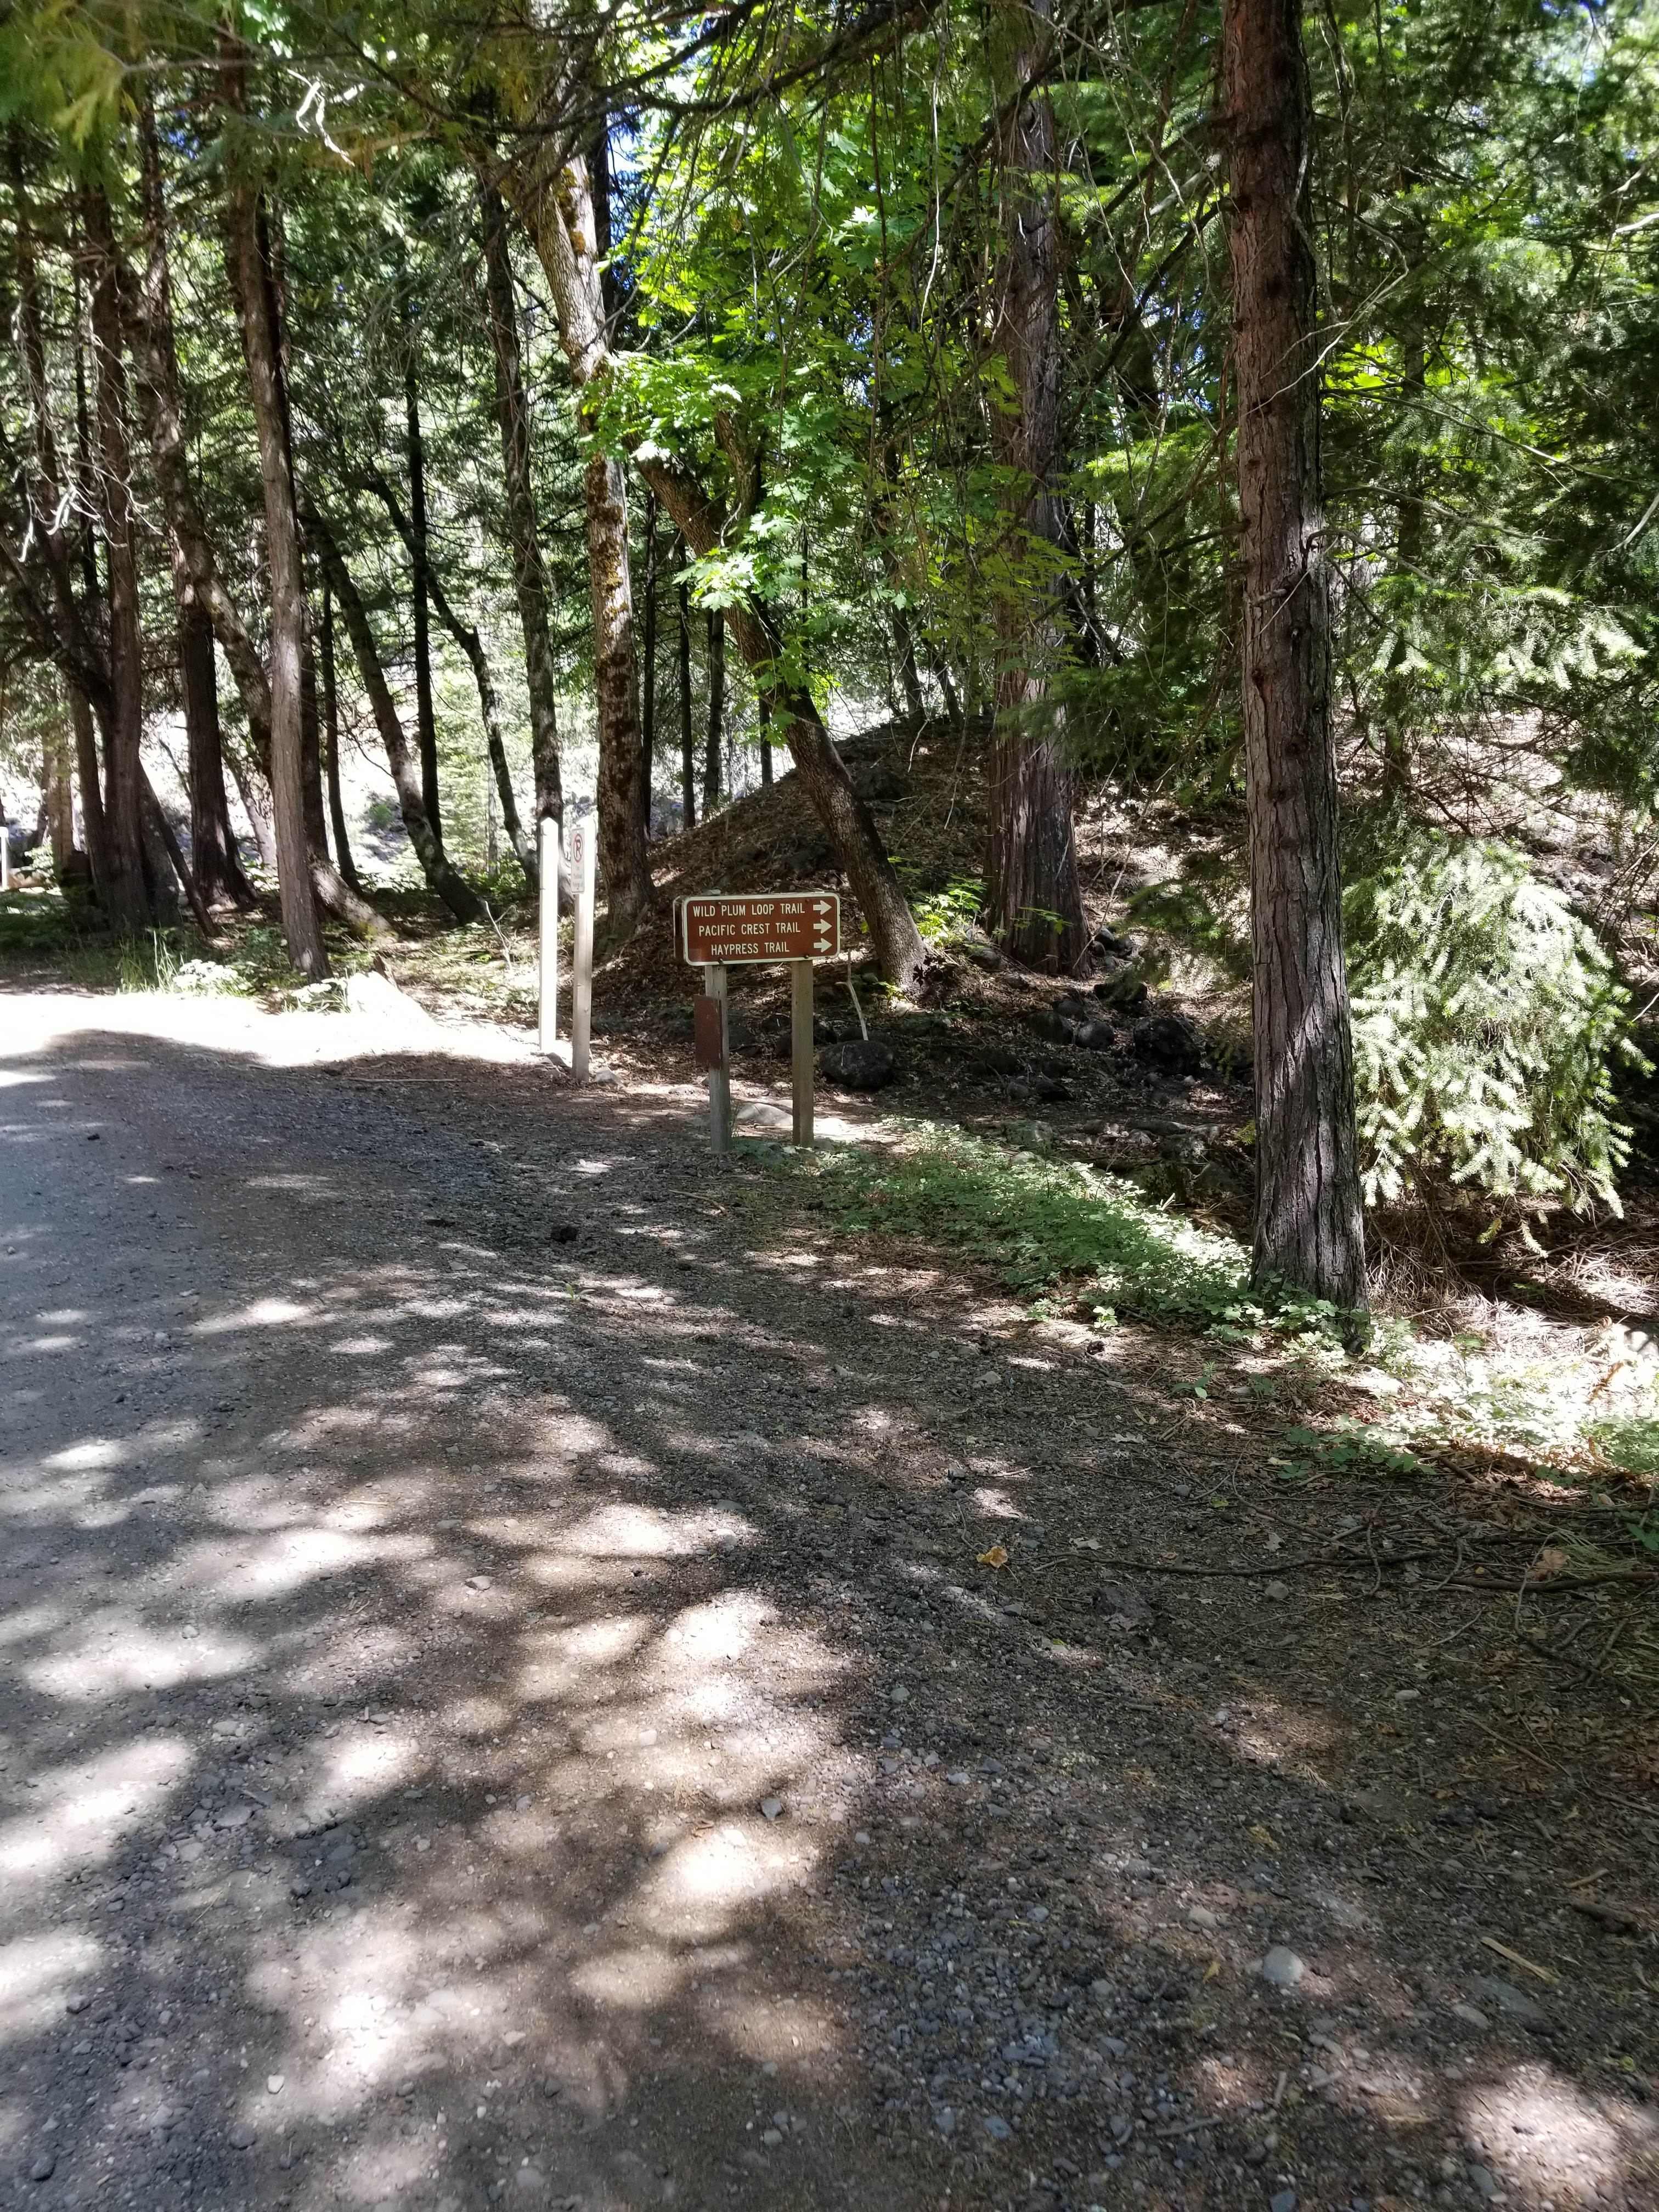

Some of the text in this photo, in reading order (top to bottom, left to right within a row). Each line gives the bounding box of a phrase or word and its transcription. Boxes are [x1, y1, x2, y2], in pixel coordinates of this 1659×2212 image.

[693, 902, 805, 917] WILD PLUM LOOP TRAIL
[699, 922, 801, 936] PACIFIC CREST TRAIL
[711, 941, 790, 956] HAYPRESS TRAIL
